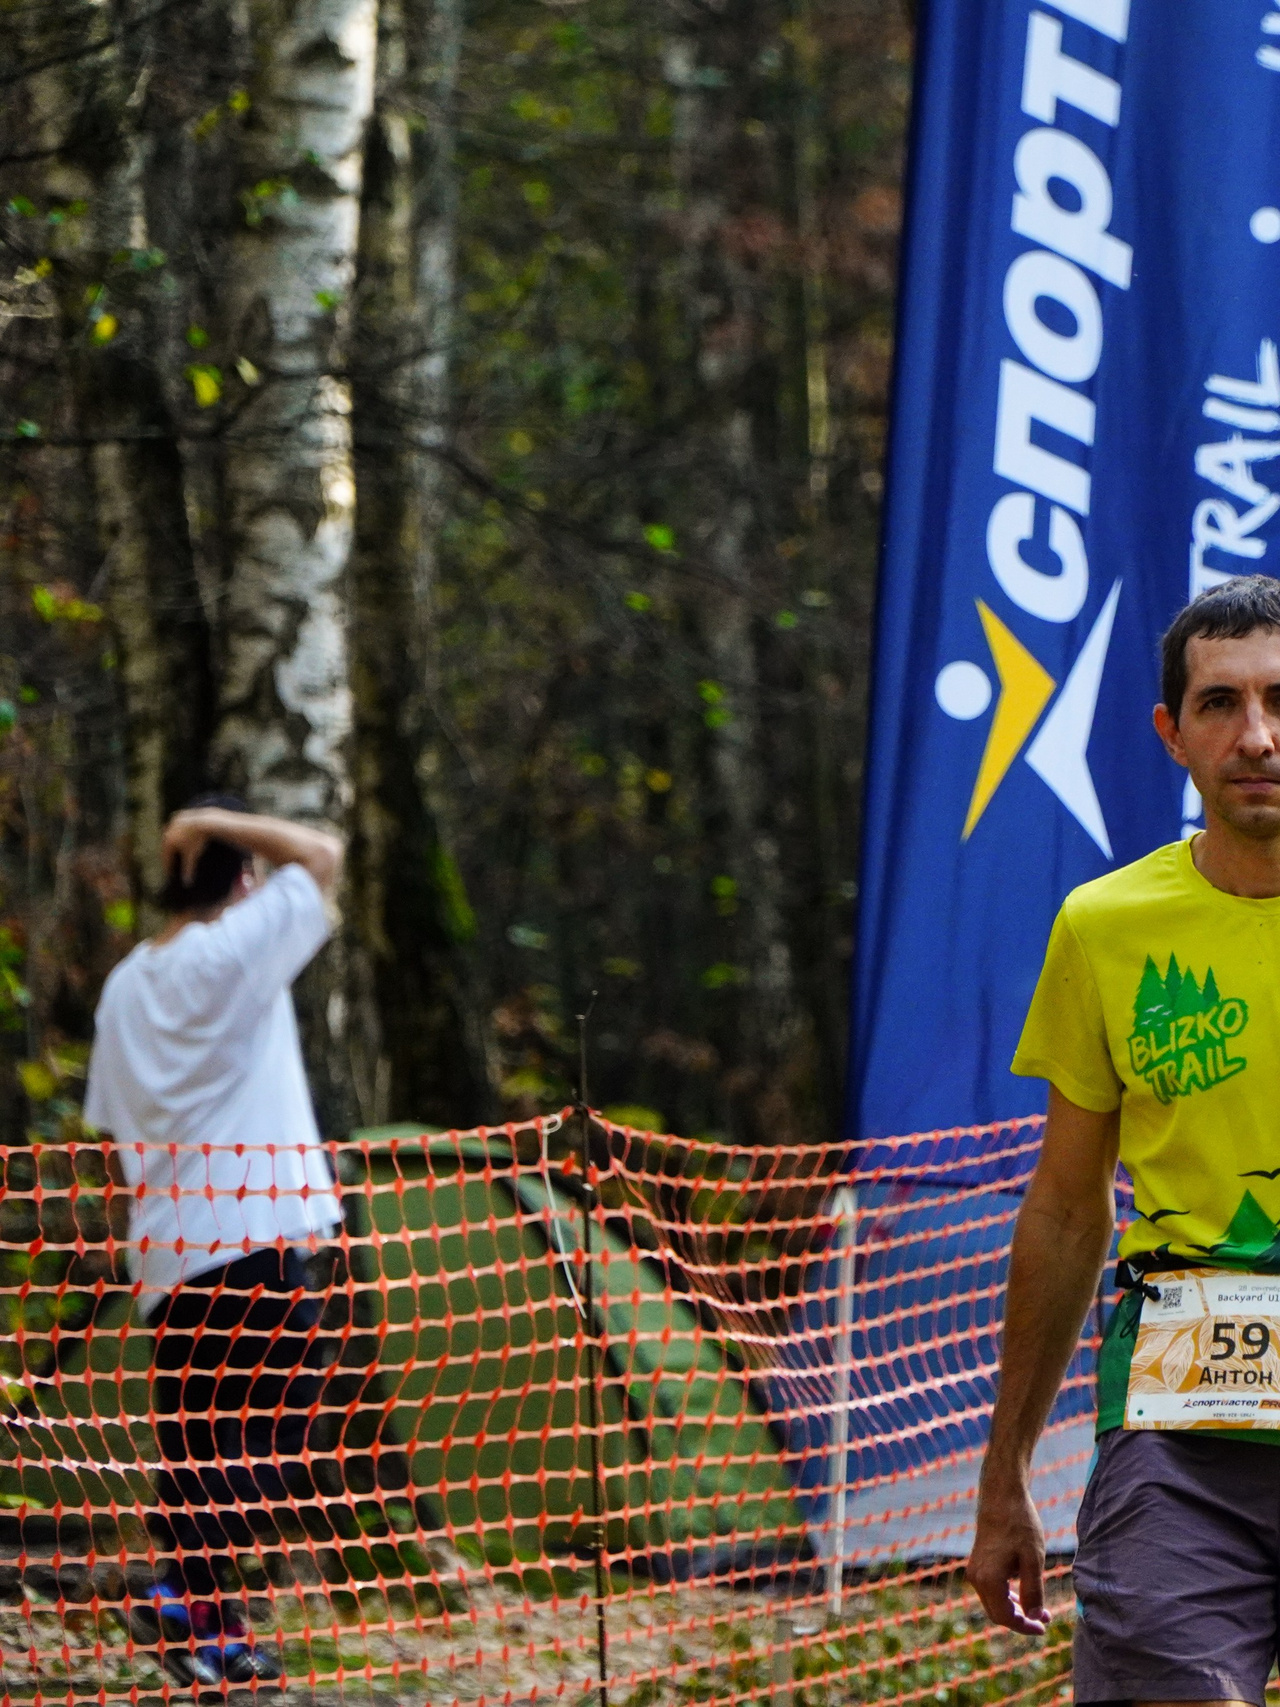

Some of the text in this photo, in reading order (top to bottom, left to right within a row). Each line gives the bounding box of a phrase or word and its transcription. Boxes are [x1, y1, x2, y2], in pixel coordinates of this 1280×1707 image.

[1130, 1000, 1245, 1073] BLIZKO
[1145, 1045, 1244, 1102] TRAIL
[1217, 1294, 1263, 1304] Backyard
[1210, 1322, 1271, 1361] 59
